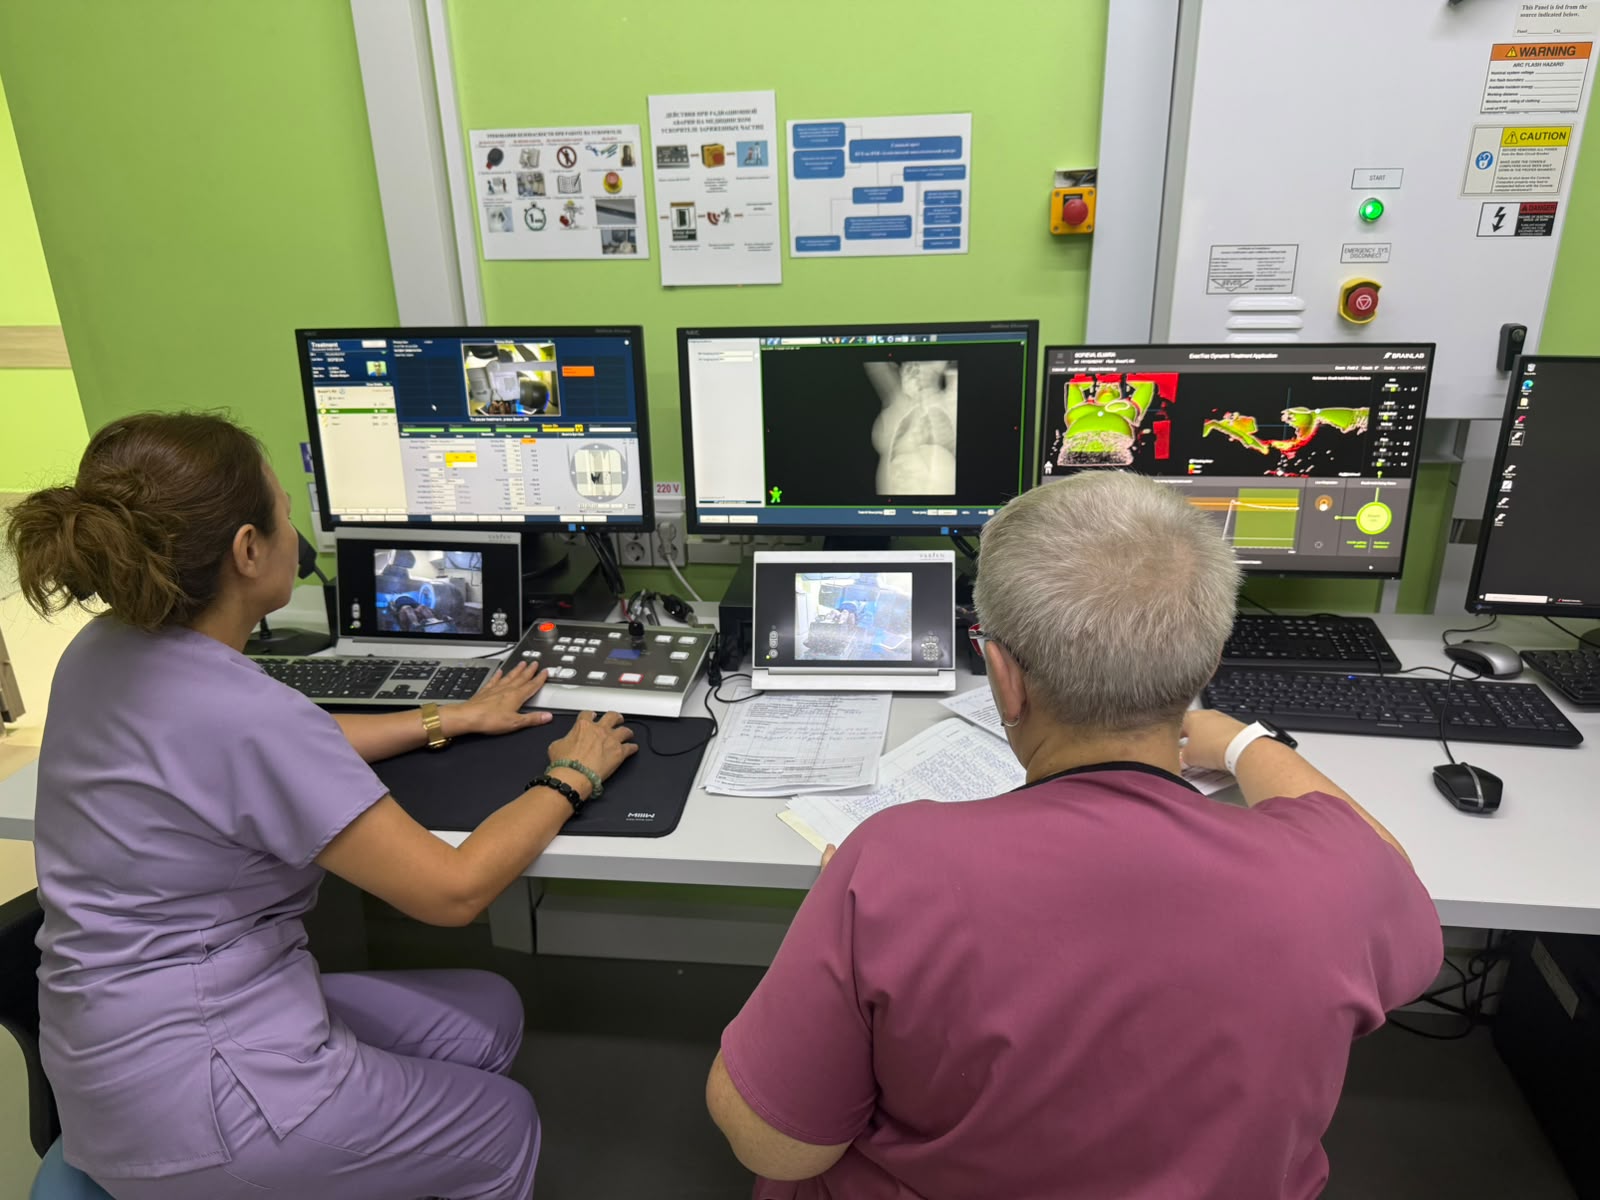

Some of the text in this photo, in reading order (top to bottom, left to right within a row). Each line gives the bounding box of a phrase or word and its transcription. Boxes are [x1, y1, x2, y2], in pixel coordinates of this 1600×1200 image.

[1519, 46, 1576, 57] WARNING
[1520, 132, 1566, 140] CAUTION
[656, 483, 680, 493] 220 V
